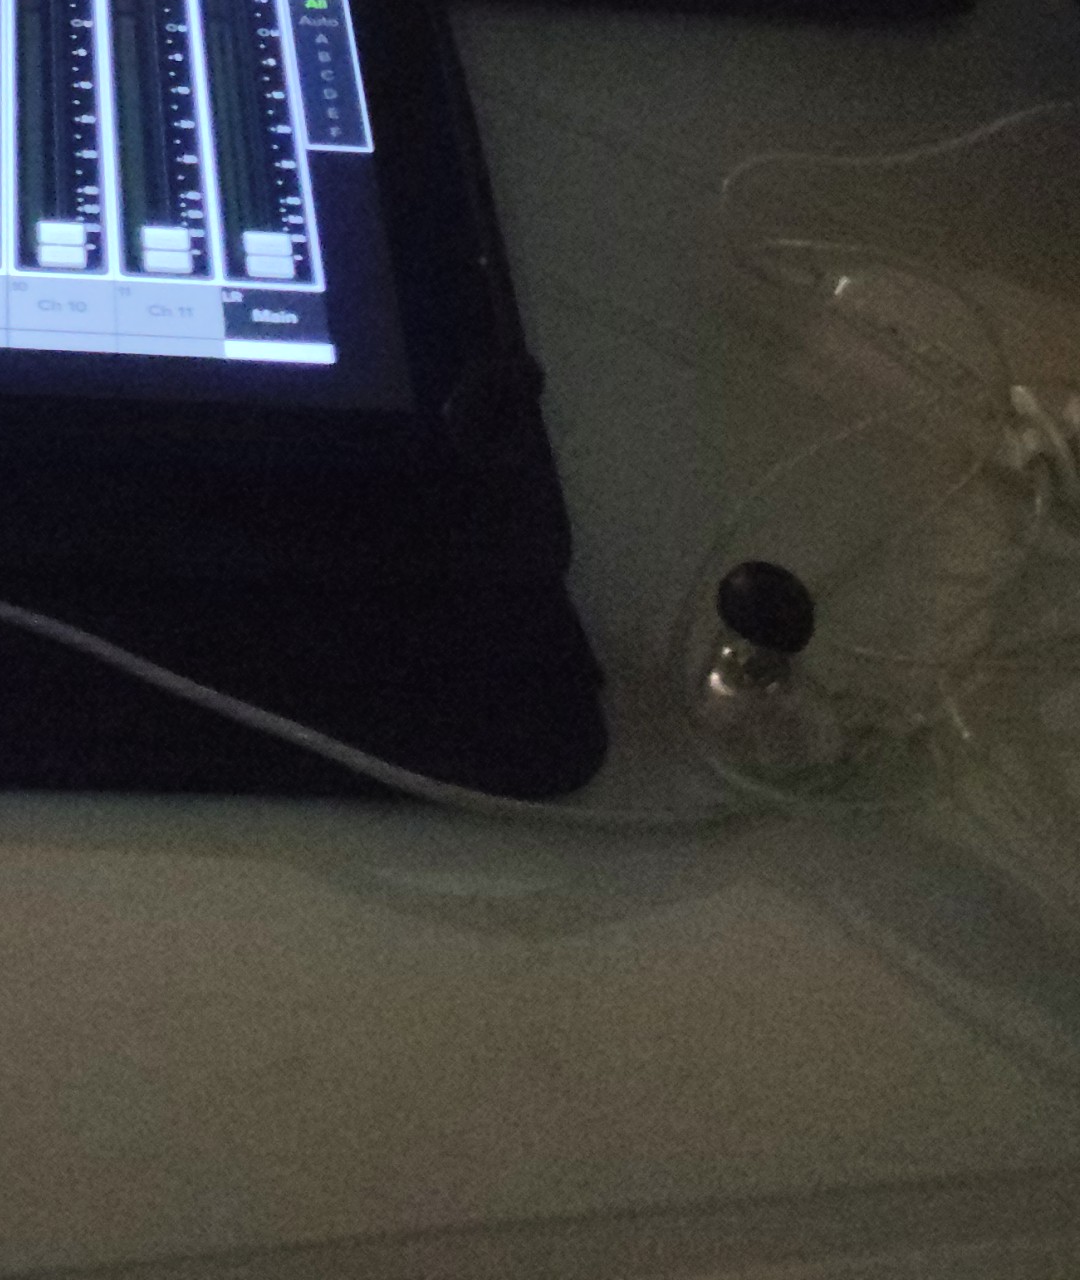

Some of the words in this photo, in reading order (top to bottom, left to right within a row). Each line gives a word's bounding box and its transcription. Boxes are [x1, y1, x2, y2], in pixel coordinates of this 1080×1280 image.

[298, 15, 339, 28] Auto
[37, 298, 62, 312] Ch
[67, 300, 88, 313] 10
[147, 304, 173, 318] Ch
[178, 306, 194, 318] 11
[251, 308, 299, 324] Main
